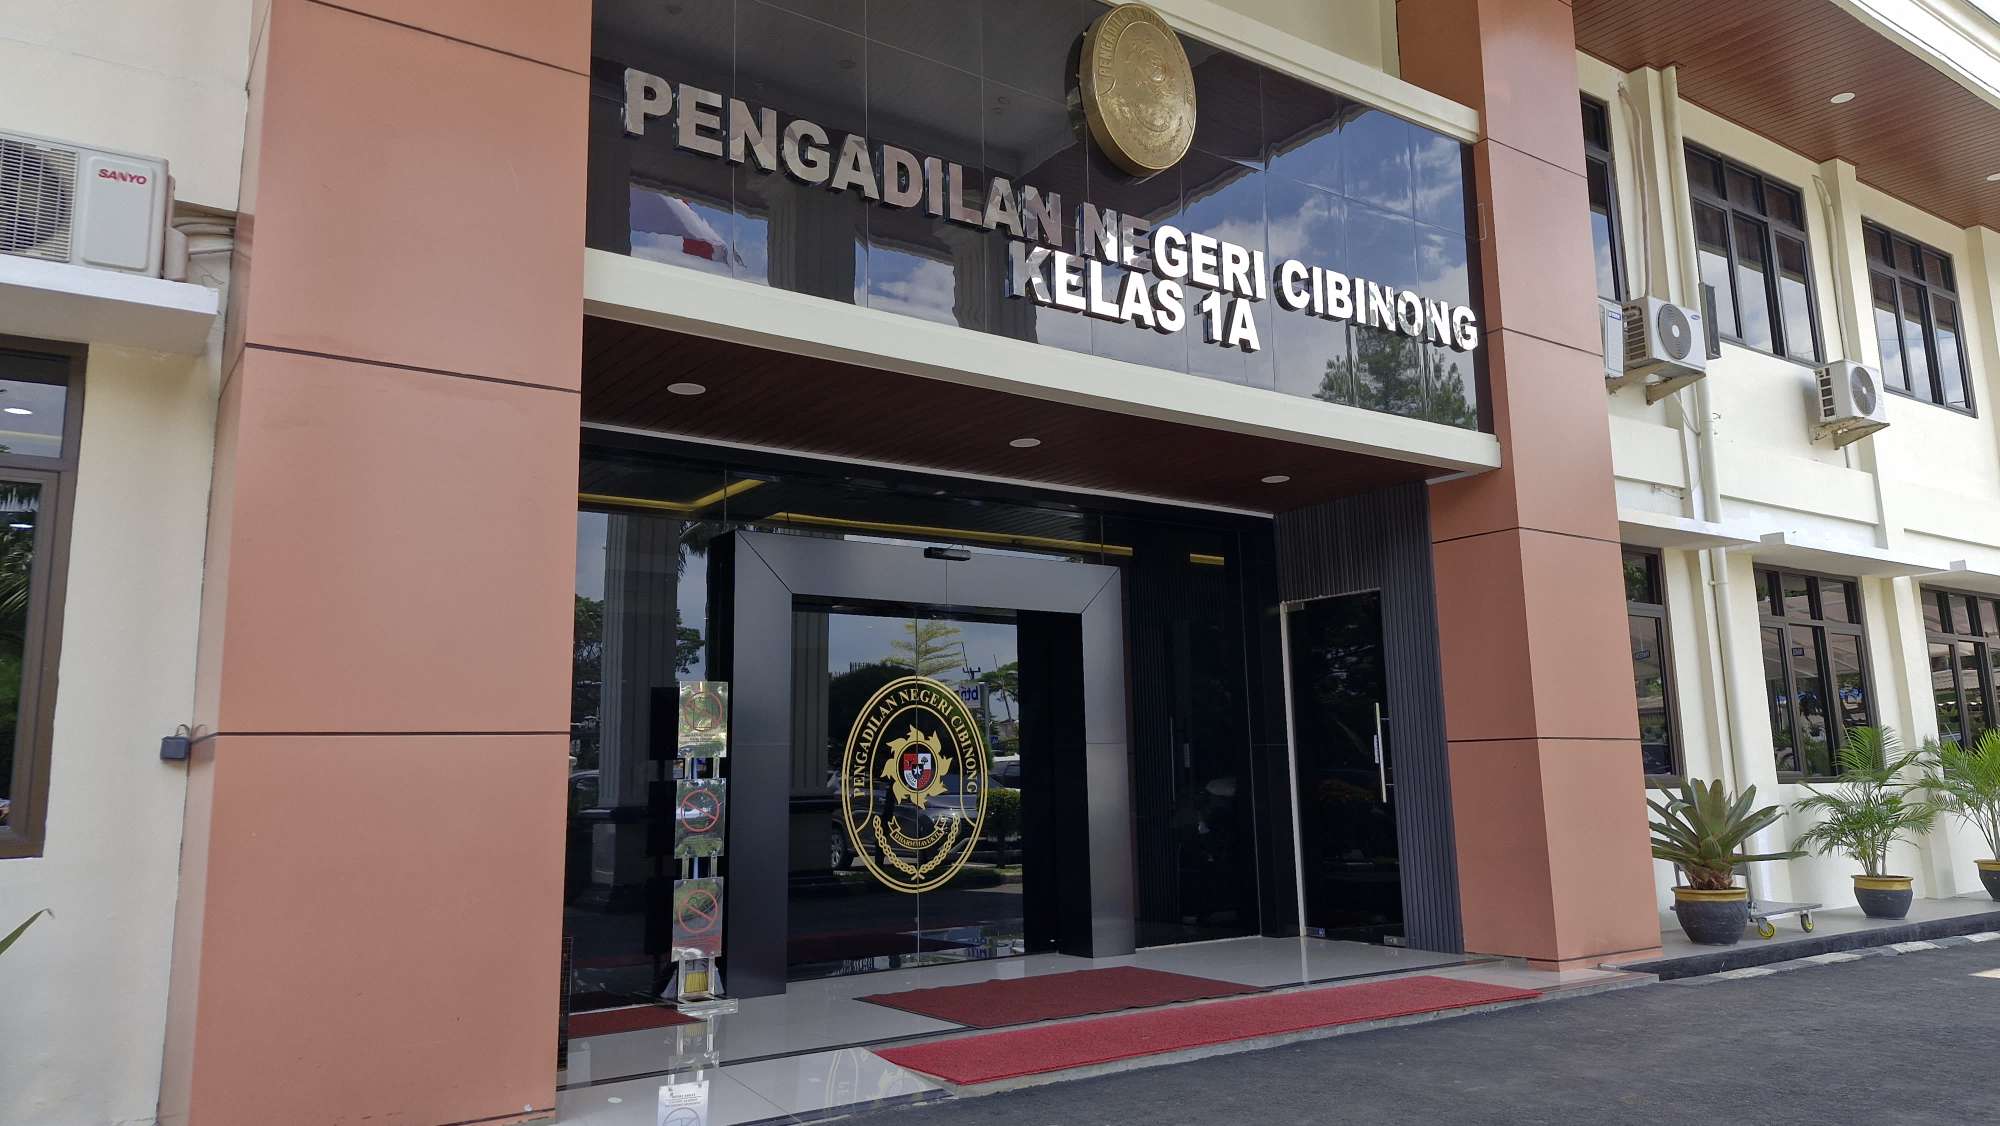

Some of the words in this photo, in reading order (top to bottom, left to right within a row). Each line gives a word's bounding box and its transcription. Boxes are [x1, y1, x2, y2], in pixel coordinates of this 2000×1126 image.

[98, 168, 147, 185] SANYO
[622, 67, 1063, 247] PENGADILAN
[1075, 201, 1266, 302] NEGERI
[1274, 259, 1478, 352] CIBINONG
[1004, 239, 1186, 334] KELAS
[1194, 291, 1261, 352] 1A
[853, 695, 898, 798] PENGADILAN
[898, 688, 953, 716] NEGERI
[950, 715, 978, 793] CIBINONG
